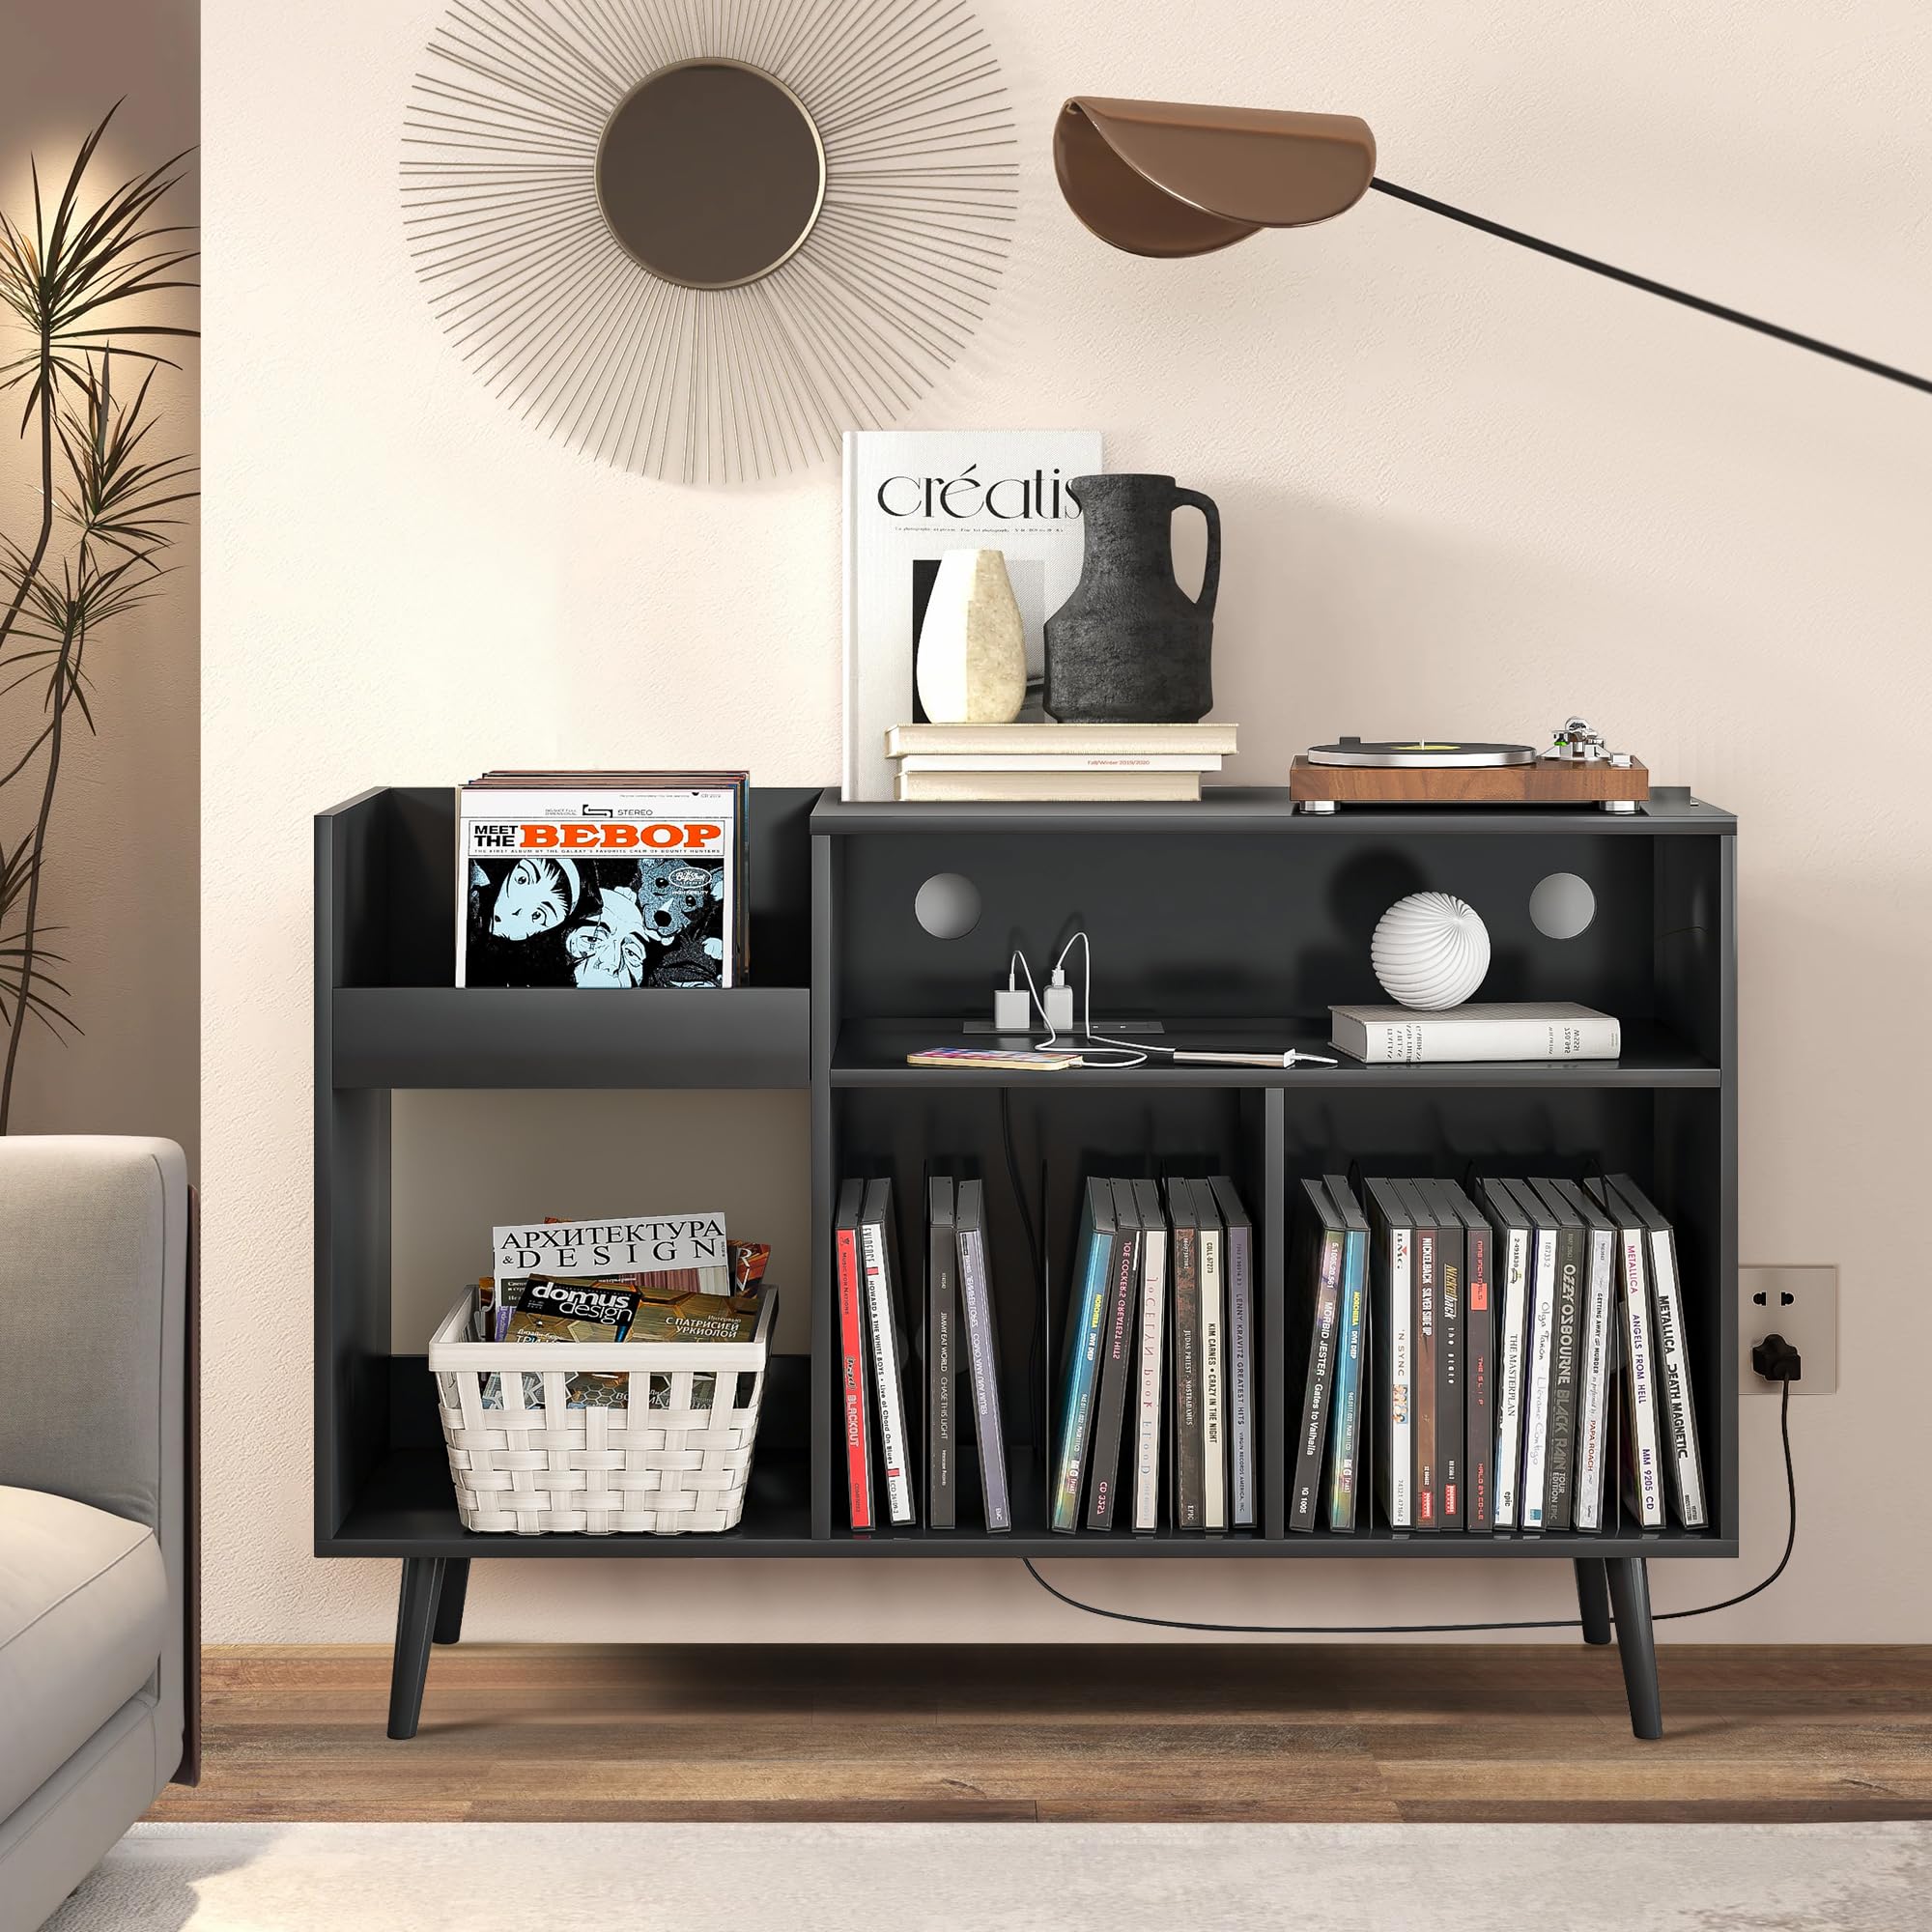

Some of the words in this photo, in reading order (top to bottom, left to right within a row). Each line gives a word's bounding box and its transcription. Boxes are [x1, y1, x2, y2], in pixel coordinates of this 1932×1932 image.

[473, 835, 515, 847] THE
[474, 825, 519, 835] MEET
[520, 824, 722, 848] BEBOP
[501, 1219, 724, 1249] АРХИТЕКТУРА
[502, 1256, 514, 1264] &
[517, 1237, 716, 1269] DESIGN
[1422, 1237, 1432, 1284] NICKELBACK
[1627, 1245, 1638, 1293] METALLICA
[531, 1282, 631, 1308] domus
[1562, 1264, 1577, 1304] OZZY
[559, 1297, 633, 1325] design
[1422, 1288, 1432, 1311] SILVER
[1539, 1301, 1550, 1327] Olga
[1321, 1301, 1333, 1339] MORBID
[1422, 1311, 1432, 1326] SIDE
[1422, 1326, 1432, 1336] UP
[1633, 1314, 1643, 1350] ANGELS
[1659, 1295, 1676, 1354] METALLICA
[1089, 1332, 1097, 1346] DIVE
[1557, 1304, 1575, 1385] OSBOURNE
[868, 1280, 878, 1312] HOWARD
[876, 1357, 885, 1376] BOYS
[885, 1434, 892, 1444] On
[1316, 1340, 1328, 1377] JESTER
[1635, 1354, 1644, 1379] FROM
[1312, 1383, 1323, 1409] Gates
[1508, 1354, 1518, 1416] MASTERPLAN
[1637, 1384, 1646, 1405] HELL
[1666, 1363, 1681, 1400] DEATH
[848, 1395, 860, 1447] BLACKOUT
[1311, 1410, 1321, 1420] to
[1555, 1389, 1570, 1434] BLACK
[1306, 1422, 1319, 1456] Valhalla
[1530, 1422, 1545, 1465] Contigo
[1671, 1402, 1689, 1459] MAGNETIC
[1553, 1438, 1568, 1469] RAIN
[1587, 1443, 1596, 1472] ROACH
[1642, 1449, 1651, 1465] MM
[1551, 1472, 1560, 1503] EDITION
[1644, 1469, 1653, 1492] 9205
[1299, 1497, 1309, 1514] 1005
[1504, 1492, 1513, 1507] epic
[1646, 1496, 1654, 1510] CD
